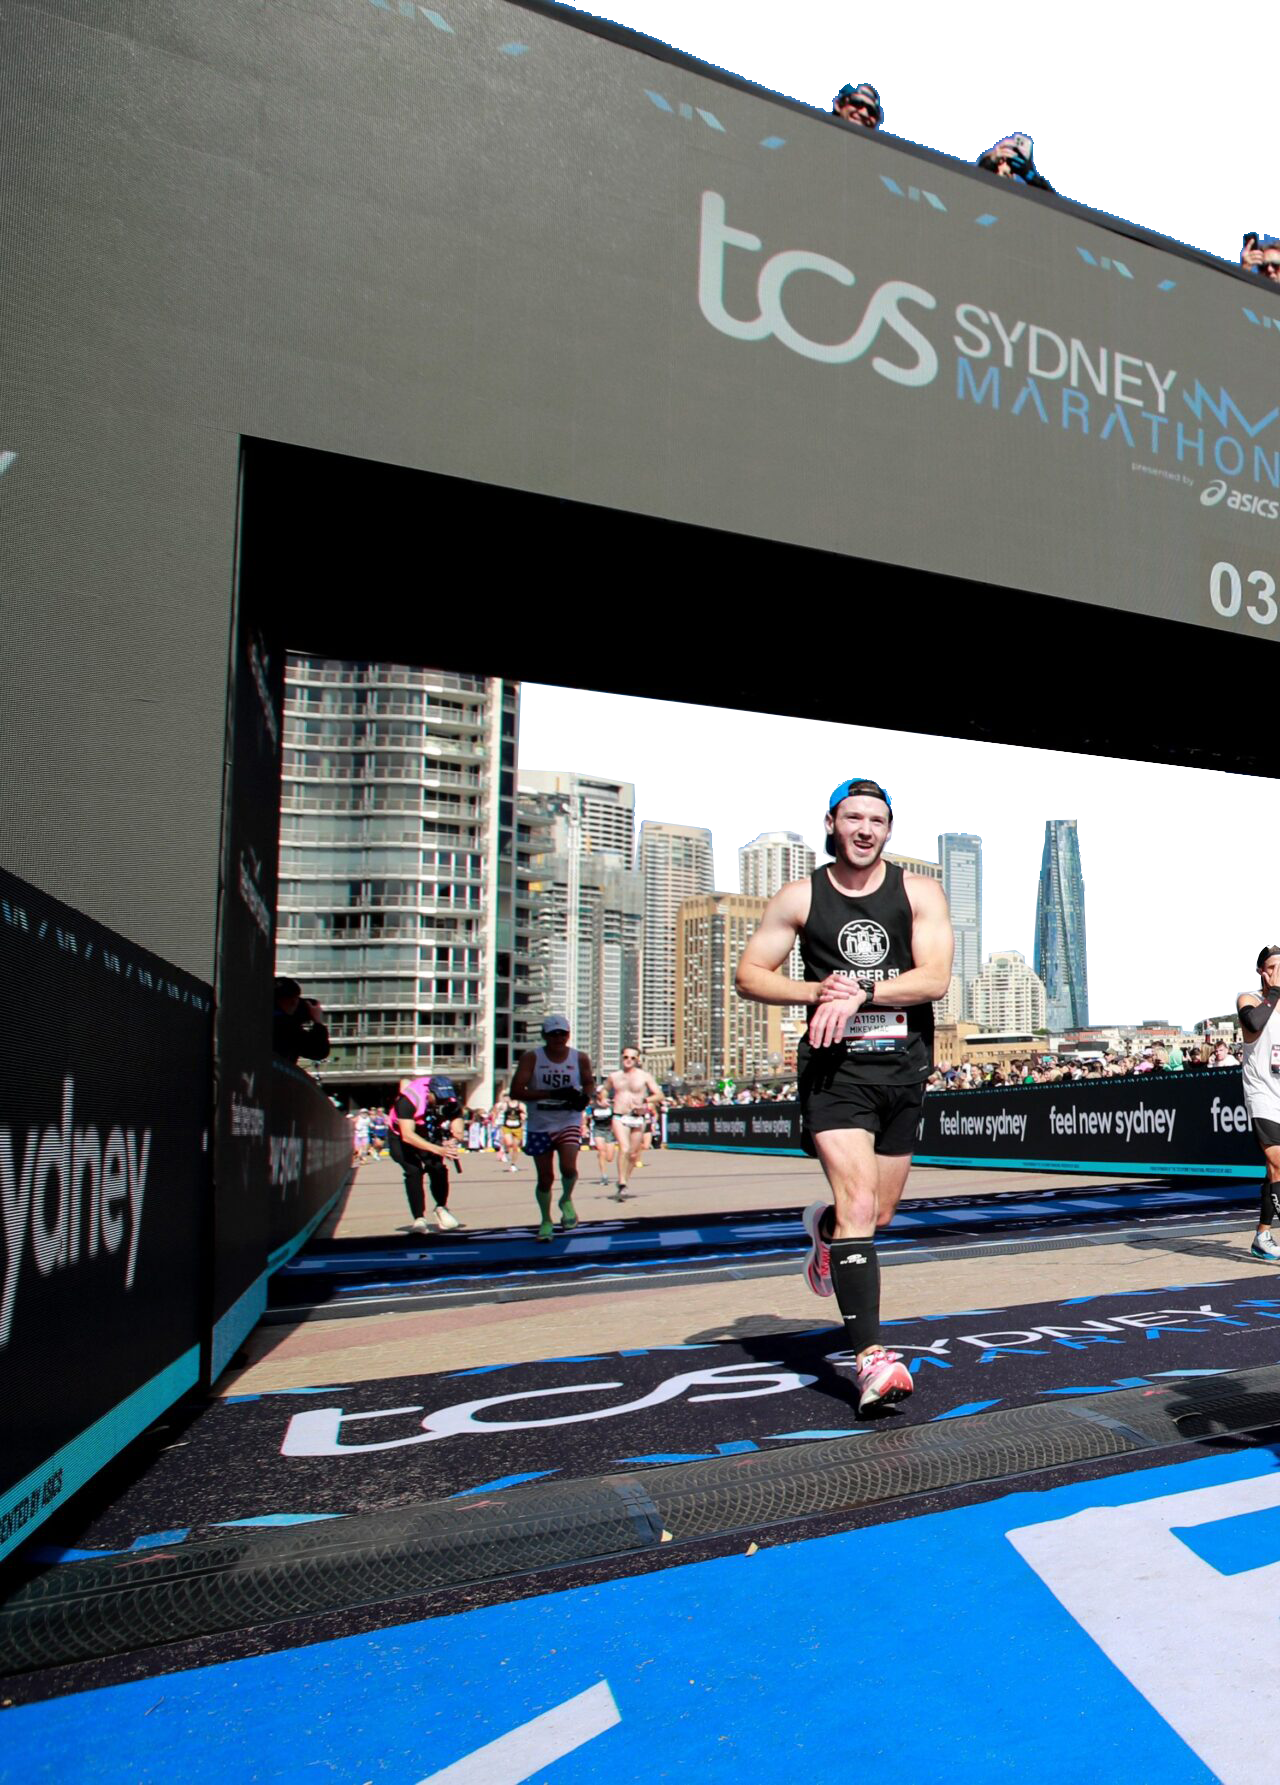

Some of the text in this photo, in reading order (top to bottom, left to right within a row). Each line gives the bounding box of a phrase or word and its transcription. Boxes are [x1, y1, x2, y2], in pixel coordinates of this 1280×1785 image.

[699, 190, 938, 387] tcs
[953, 303, 1177, 414] SYDNEY
[956, 357, 1280, 489] MARATHON
[1227, 490, 1279, 519] asics
[853, 1014, 886, 1025] A11916
[543, 1073, 571, 1088] USA
[940, 1111, 960, 1136] feel
[960, 1114, 984, 1135] new
[985, 1108, 1028, 1142] sydney
[1050, 1101, 1176, 1143] feel new sydney
[281, 1362, 818, 1456] tcs
